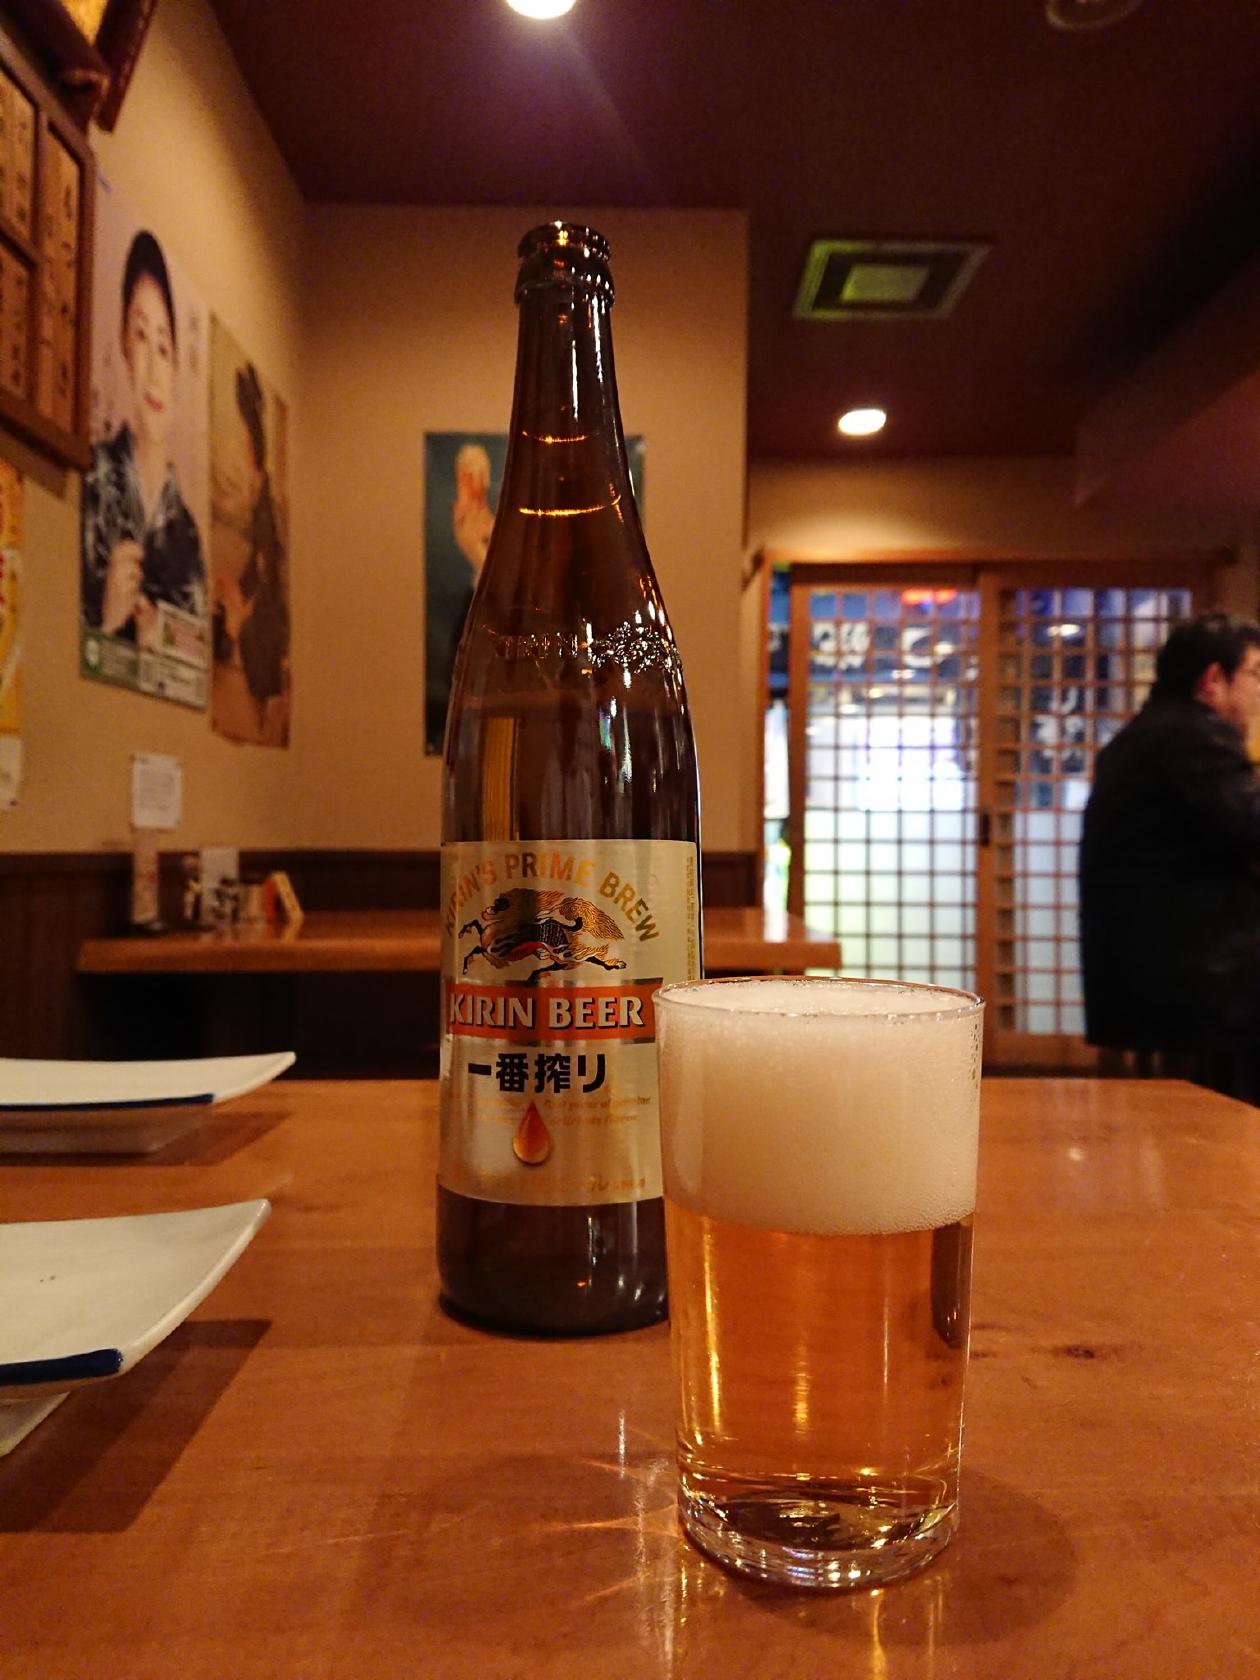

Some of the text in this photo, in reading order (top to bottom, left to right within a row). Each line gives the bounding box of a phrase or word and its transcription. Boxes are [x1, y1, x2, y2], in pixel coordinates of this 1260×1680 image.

[446, 858, 498, 938] KIRIN'S
[504, 850, 594, 888] PRIME
[598, 871, 660, 943] BREW
[450, 992, 645, 1030] KIRIN BEER
[467, 1052, 607, 1094] 一番搾り
